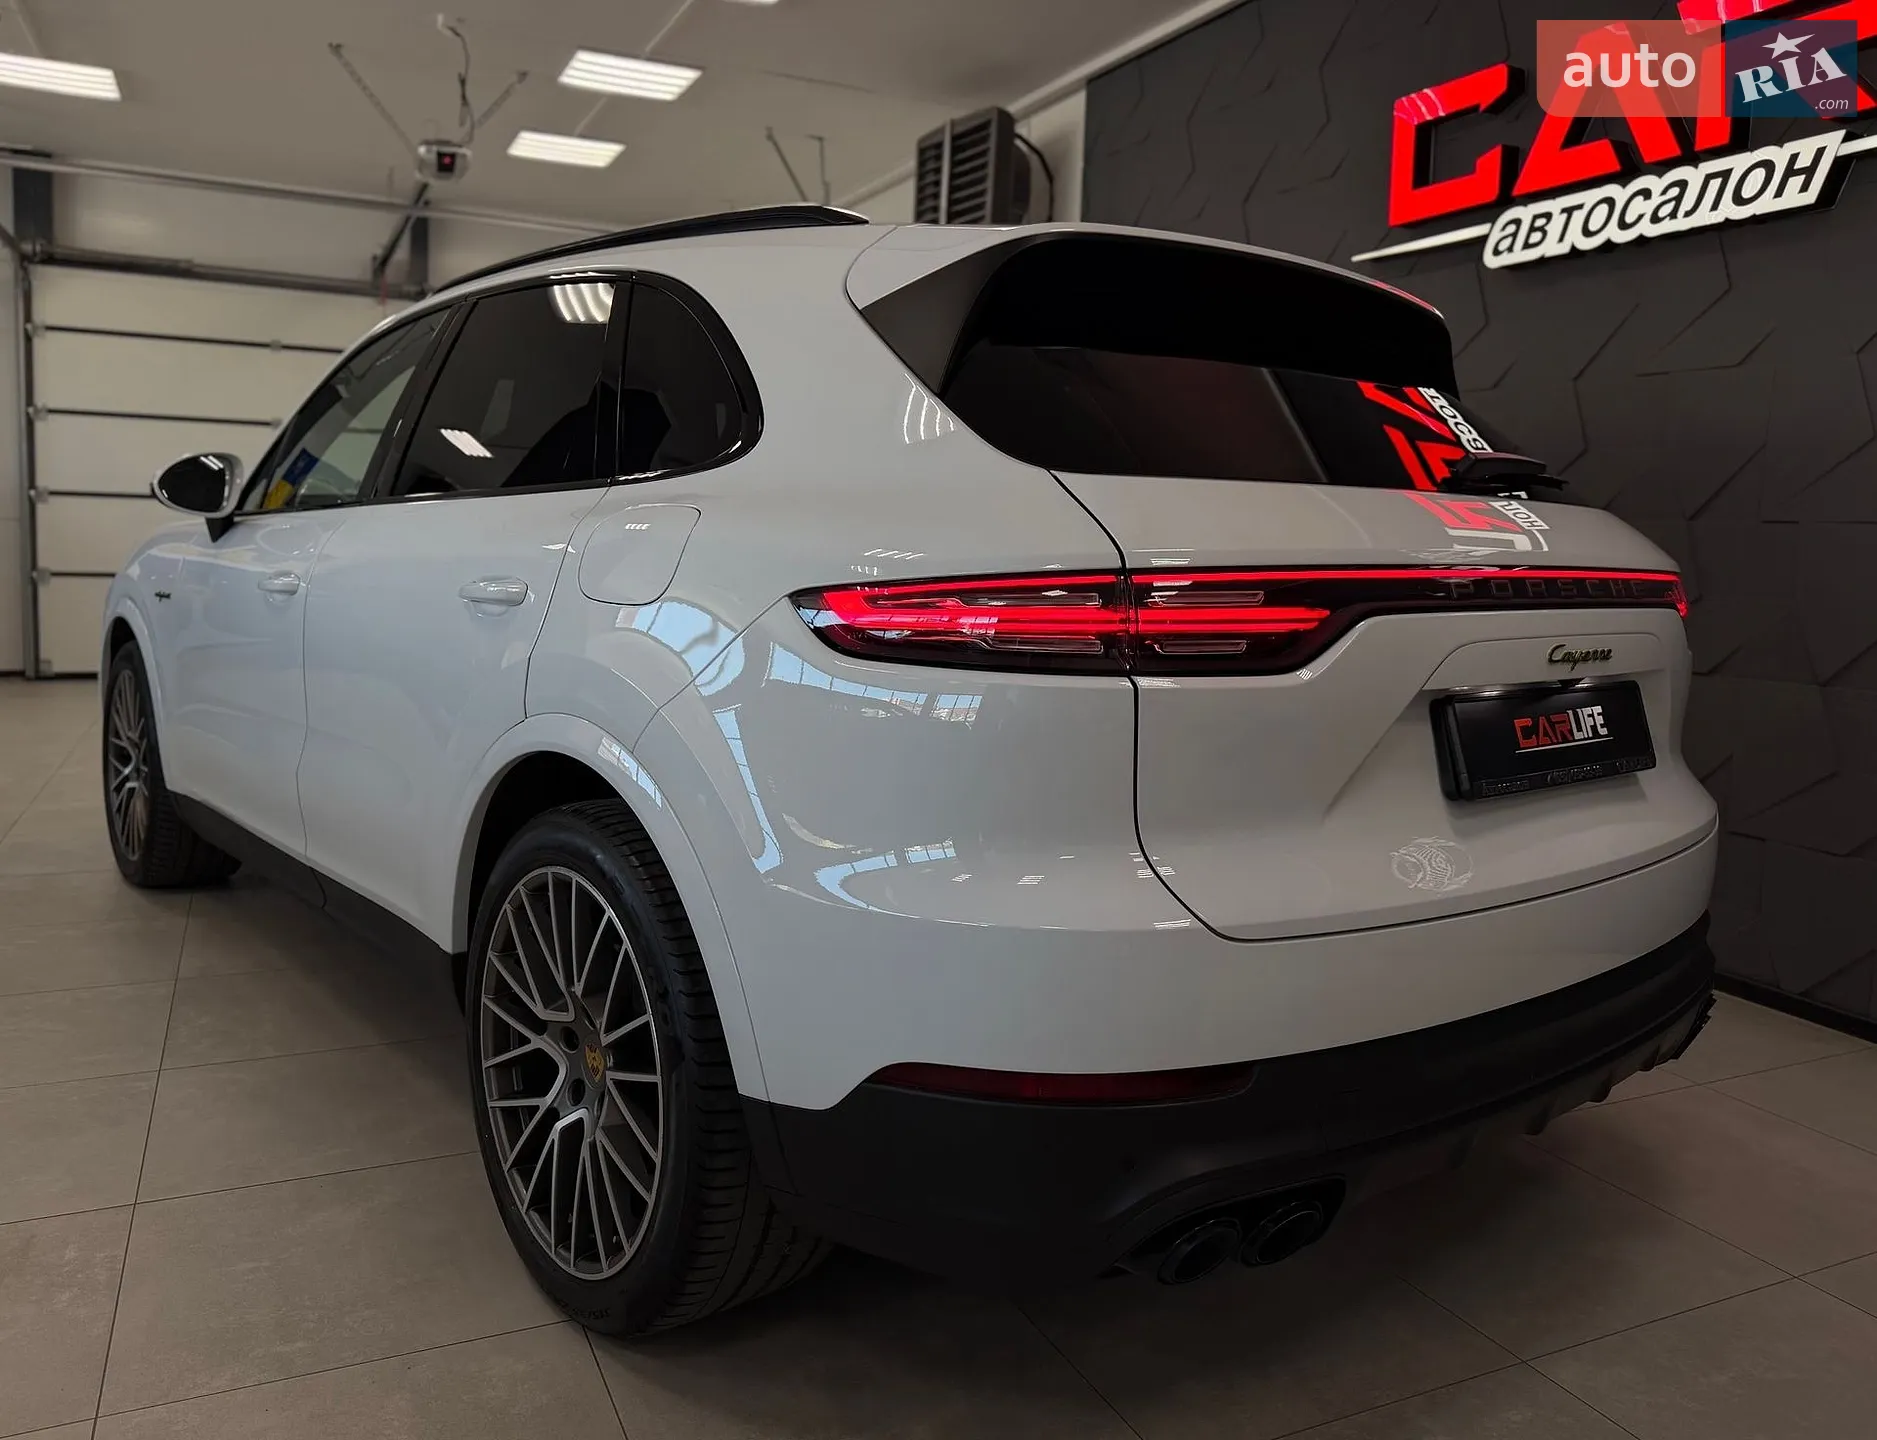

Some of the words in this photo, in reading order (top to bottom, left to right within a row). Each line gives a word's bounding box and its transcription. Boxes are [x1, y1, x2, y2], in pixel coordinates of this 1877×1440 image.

[1491, 144, 1828, 258] автосалон
[1450, 579, 1646, 599] PORSCHE
[1547, 644, 1613, 671] Cayenne
[1513, 705, 1609, 749] CARLIFE
